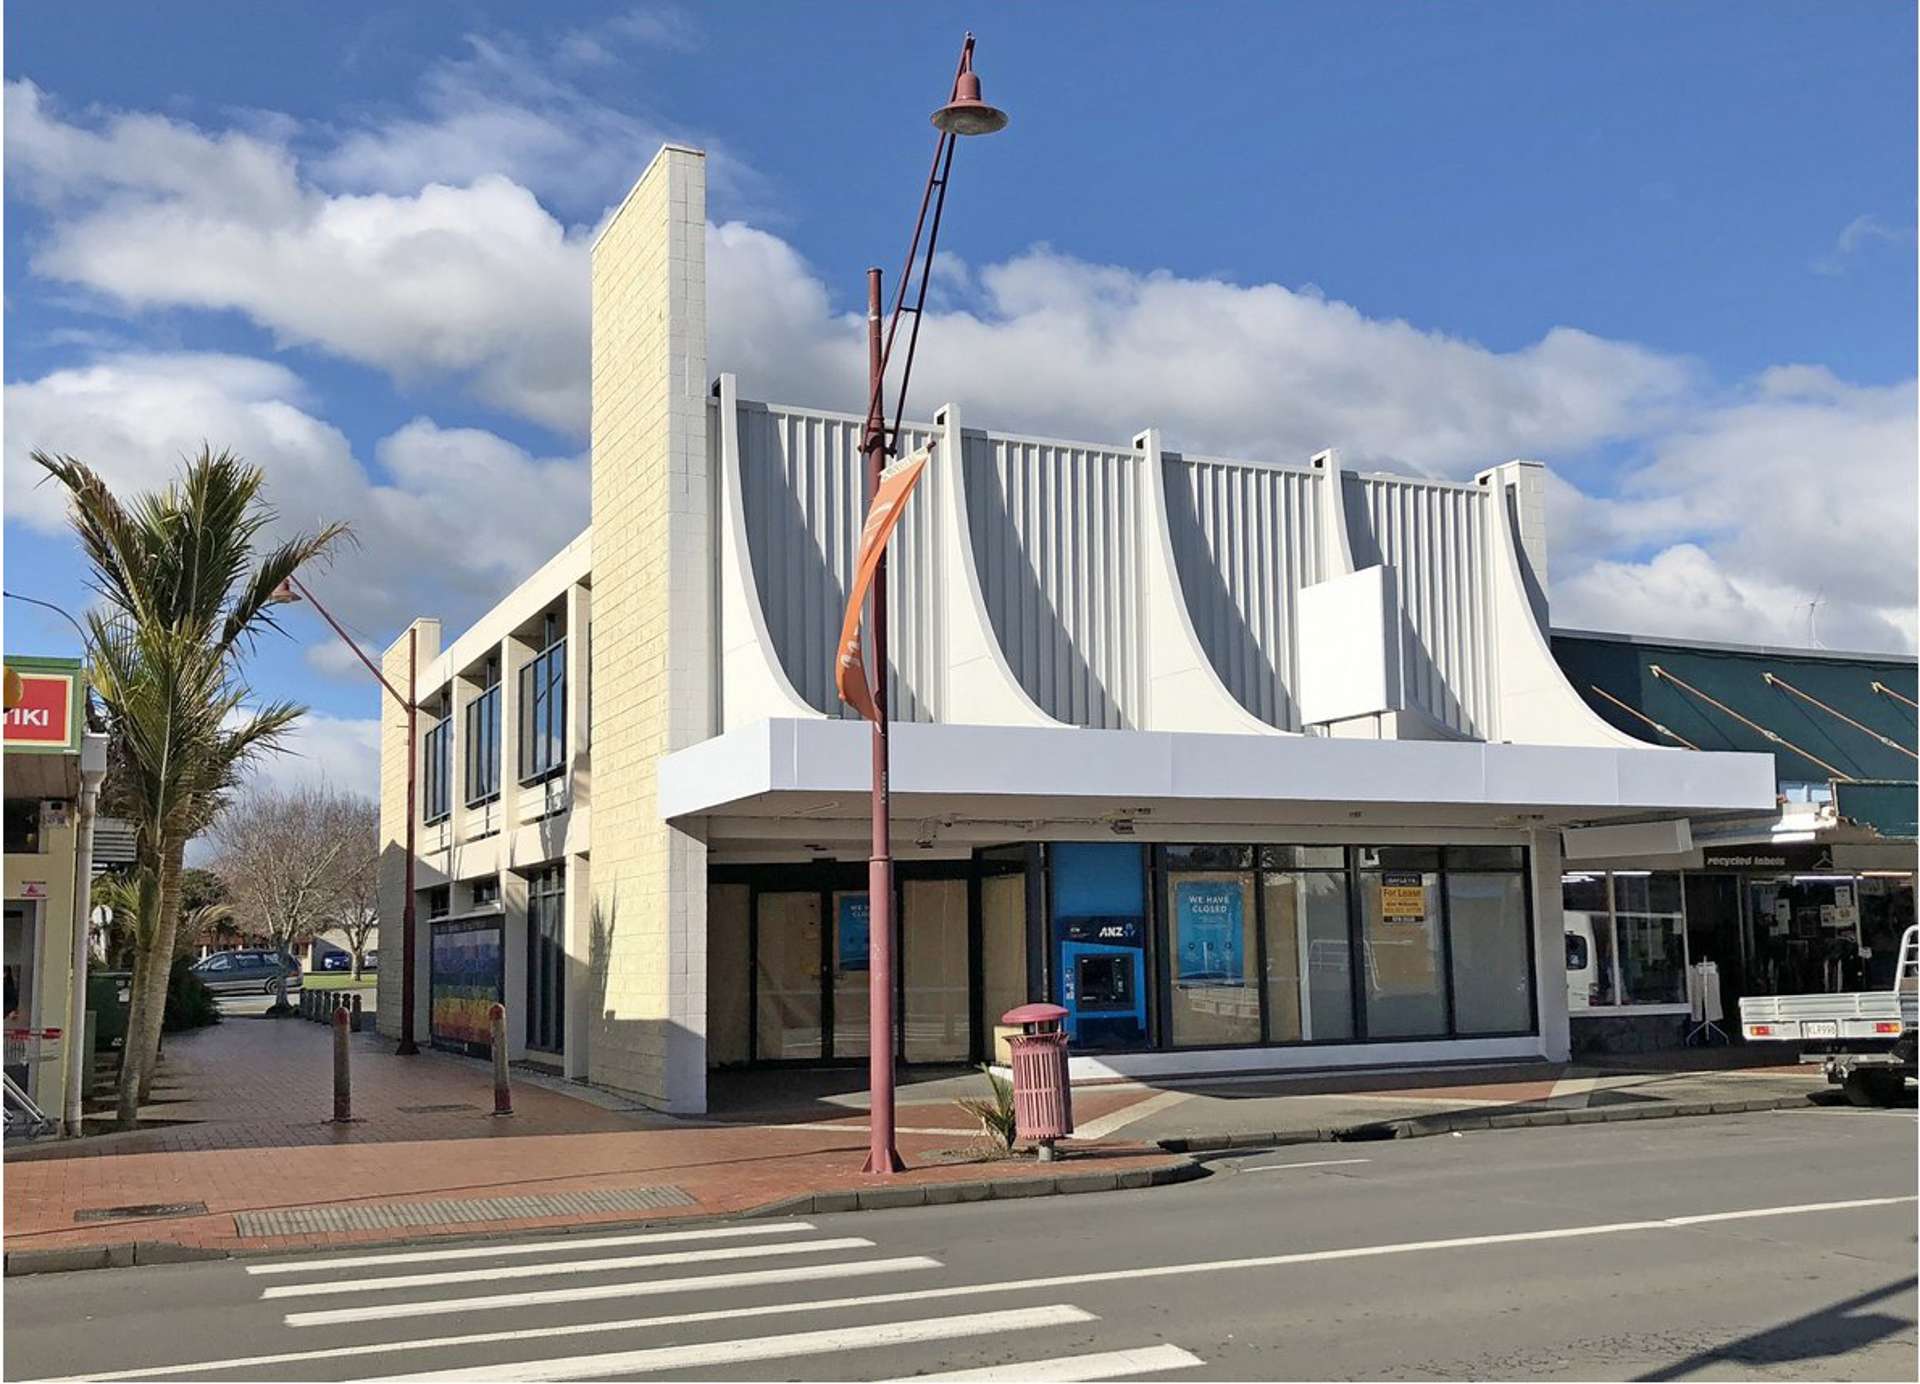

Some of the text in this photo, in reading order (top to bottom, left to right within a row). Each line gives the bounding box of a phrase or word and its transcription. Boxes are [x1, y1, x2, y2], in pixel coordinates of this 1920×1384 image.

[1707, 856, 1785, 867] recycled labels
[1189, 895, 1230, 904] WE HAVE
[1191, 904, 1228, 913] CLOSED
[1099, 926, 1124, 938] ANZ
